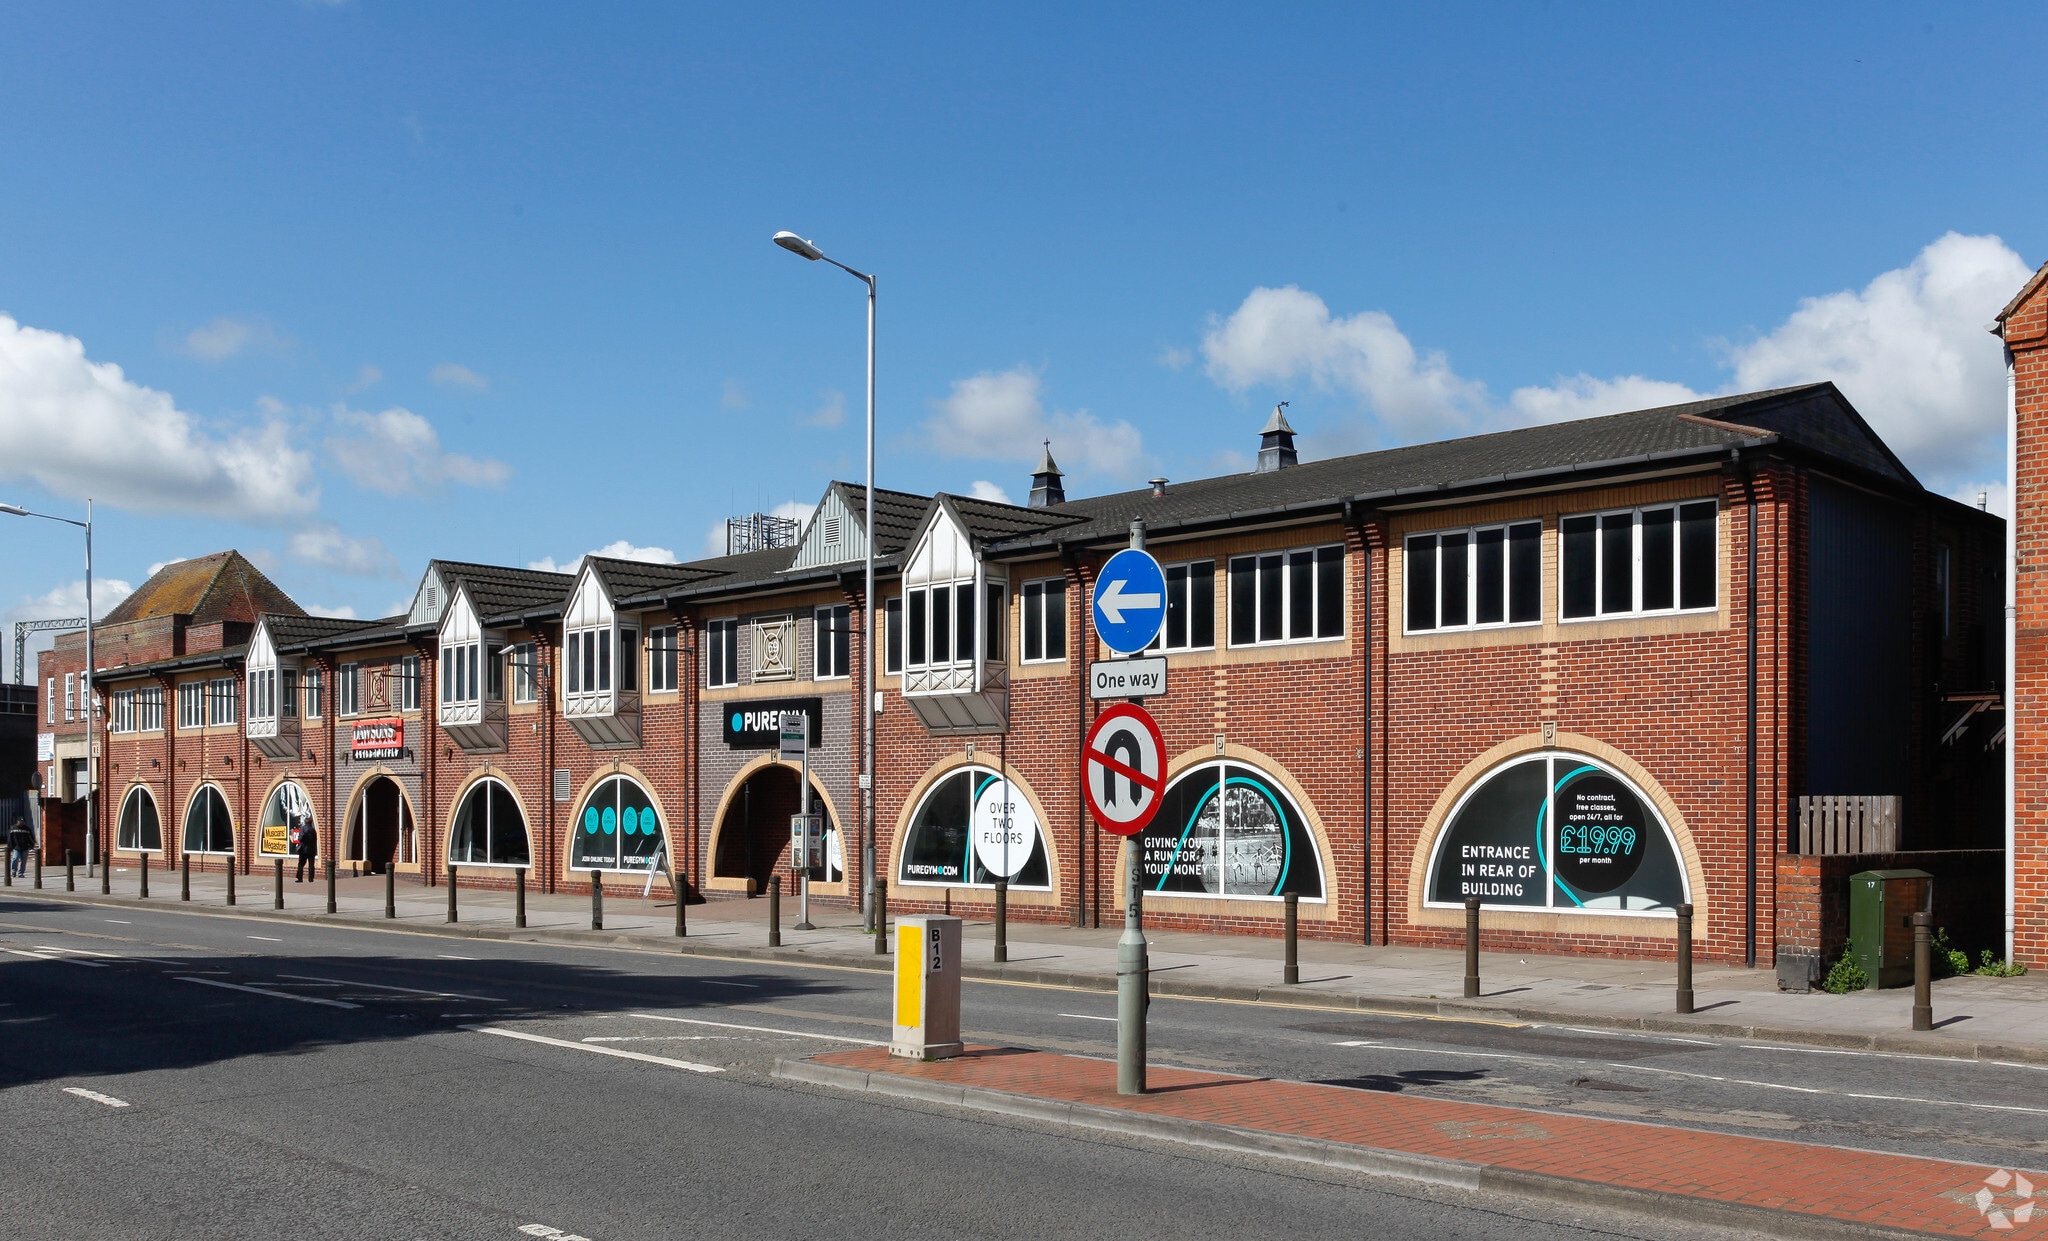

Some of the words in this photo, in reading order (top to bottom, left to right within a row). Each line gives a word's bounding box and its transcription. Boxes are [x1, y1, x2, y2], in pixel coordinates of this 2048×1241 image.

[1097, 672, 1125, 689] One
[1130, 673, 1159, 689] way
[744, 710, 806, 732] PURE
[1587, 794, 1616, 802] contract,
[989, 802, 1016, 814] OVER
[992, 817, 1014, 830] TWO
[1586, 813, 1603, 821] 24/7,
[984, 832, 1023, 845] FLOORS
[1144, 837, 1178, 848] GIVING
[1182, 837, 1202, 849] YOU
[1560, 825, 1636, 855] £19.99
[1144, 850, 1151, 861] A
[1154, 850, 1173, 861] RUN
[1176, 851, 1196, 862] FOR
[1462, 845, 1531, 859] ENTRANCE
[1144, 863, 1170, 874] YOUR
[1173, 864, 1208, 875] MONEY
[1461, 863, 1475, 877] IN
[1479, 864, 1514, 877] REAR
[1518, 865, 1537, 878] OF
[1462, 882, 1524, 896] BUILDING
